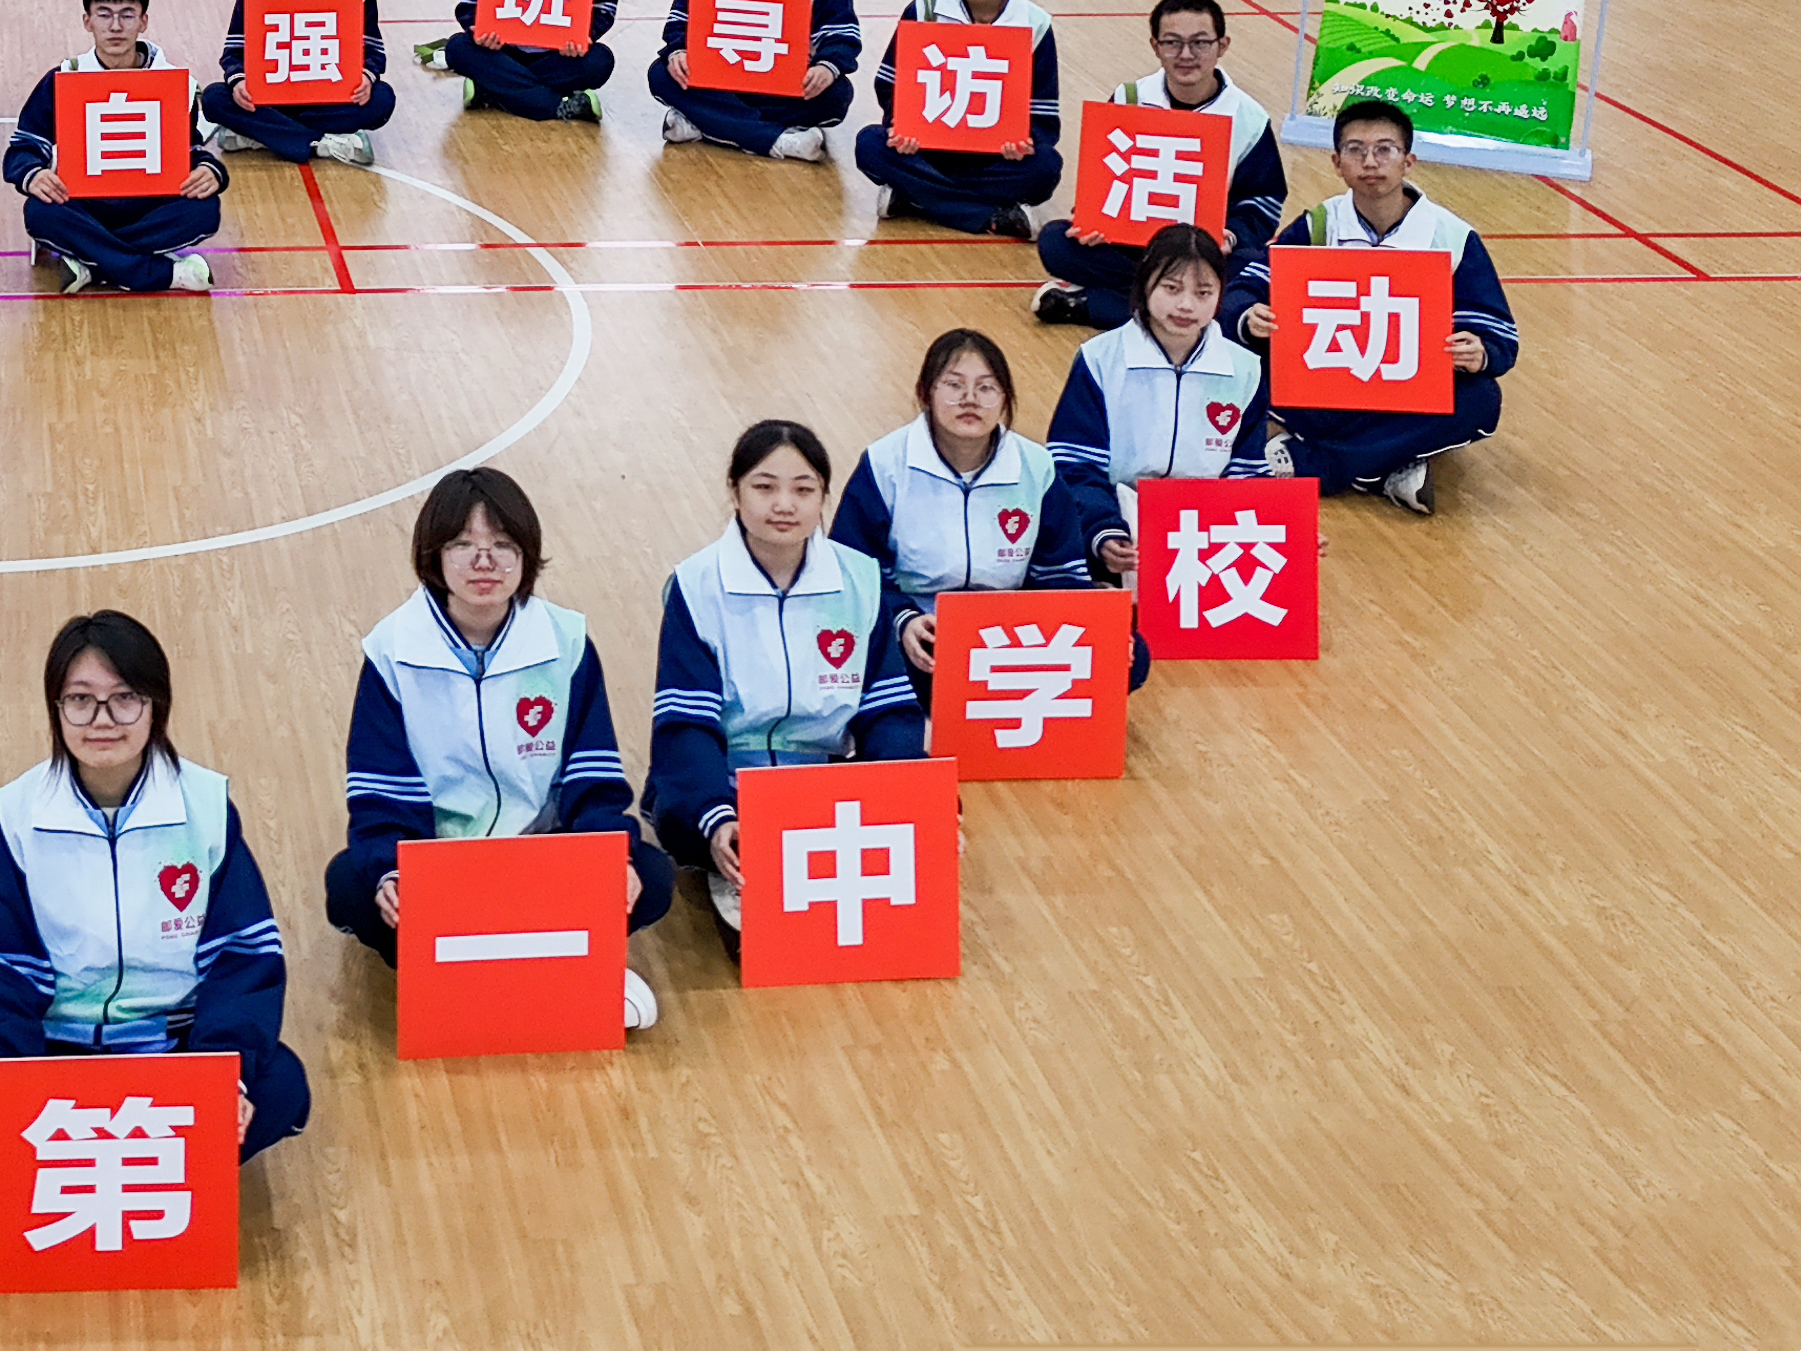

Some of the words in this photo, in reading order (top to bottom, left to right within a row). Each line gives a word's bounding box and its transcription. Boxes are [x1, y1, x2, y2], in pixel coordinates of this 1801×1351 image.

[266, 13, 343, 83] 强
[709, 0, 788, 72] 寻
[88, 95, 161, 175] 自
[919, 46, 1009, 127] 访
[1101, 127, 1203, 226] 活
[1305, 278, 1419, 381] 动
[1167, 512, 1287, 628] 校
[965, 625, 1092, 749] 学
[783, 800, 917, 946] 中
[436, 932, 589, 962] 一
[22, 1099, 194, 1251] 第
